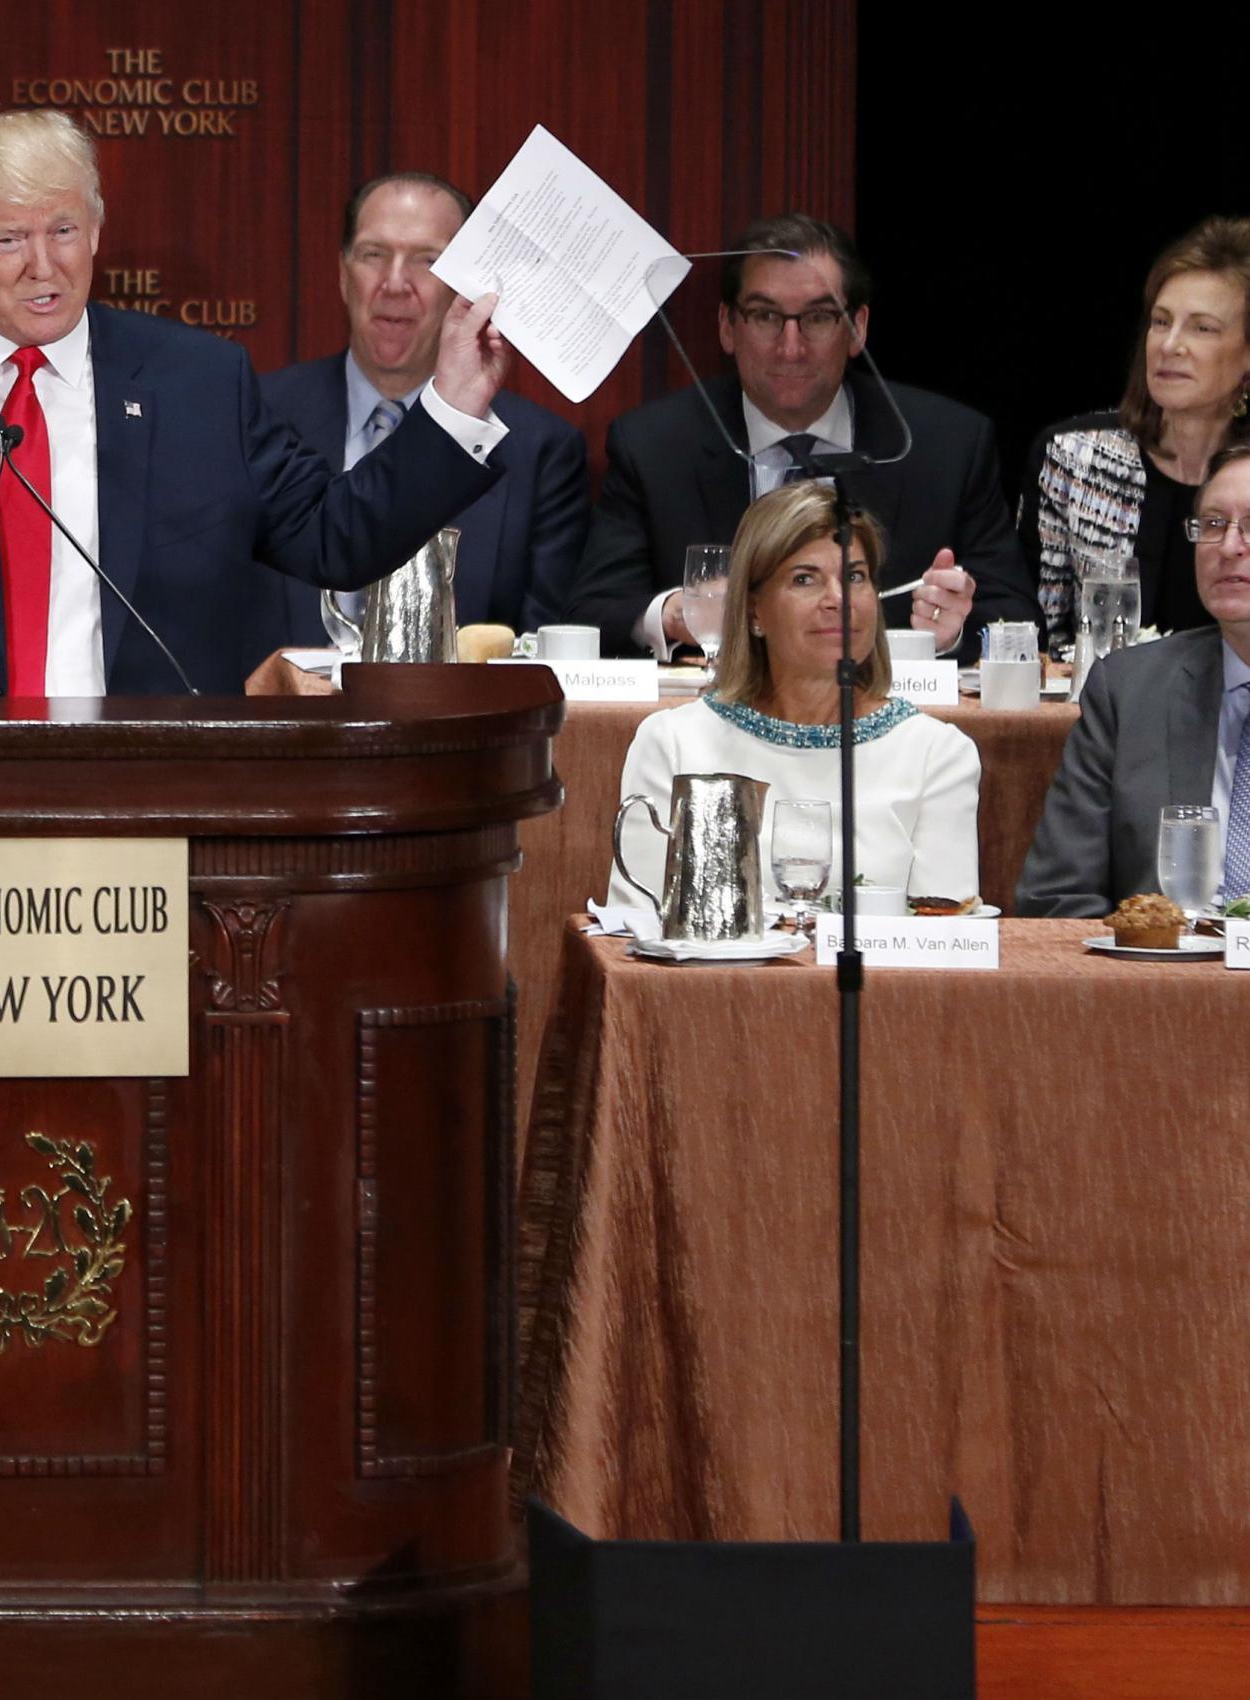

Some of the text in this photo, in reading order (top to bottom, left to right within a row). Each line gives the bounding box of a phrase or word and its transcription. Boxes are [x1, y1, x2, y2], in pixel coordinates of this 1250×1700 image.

[106, 48, 163, 74] THE
[12, 79, 259, 105] ECONOMIC CLUB
[83, 110, 236, 135] NEW YORK
[105, 269, 161, 294] THE
[180, 300, 257, 326] CLUB
[564, 672, 637, 689] Malpass
[891, 676, 938, 692] eifeld
[93, 886, 169, 934] CLUB
[827, 934, 990, 951] Babara M. Van Allen
[42, 975, 146, 1024] YORK
